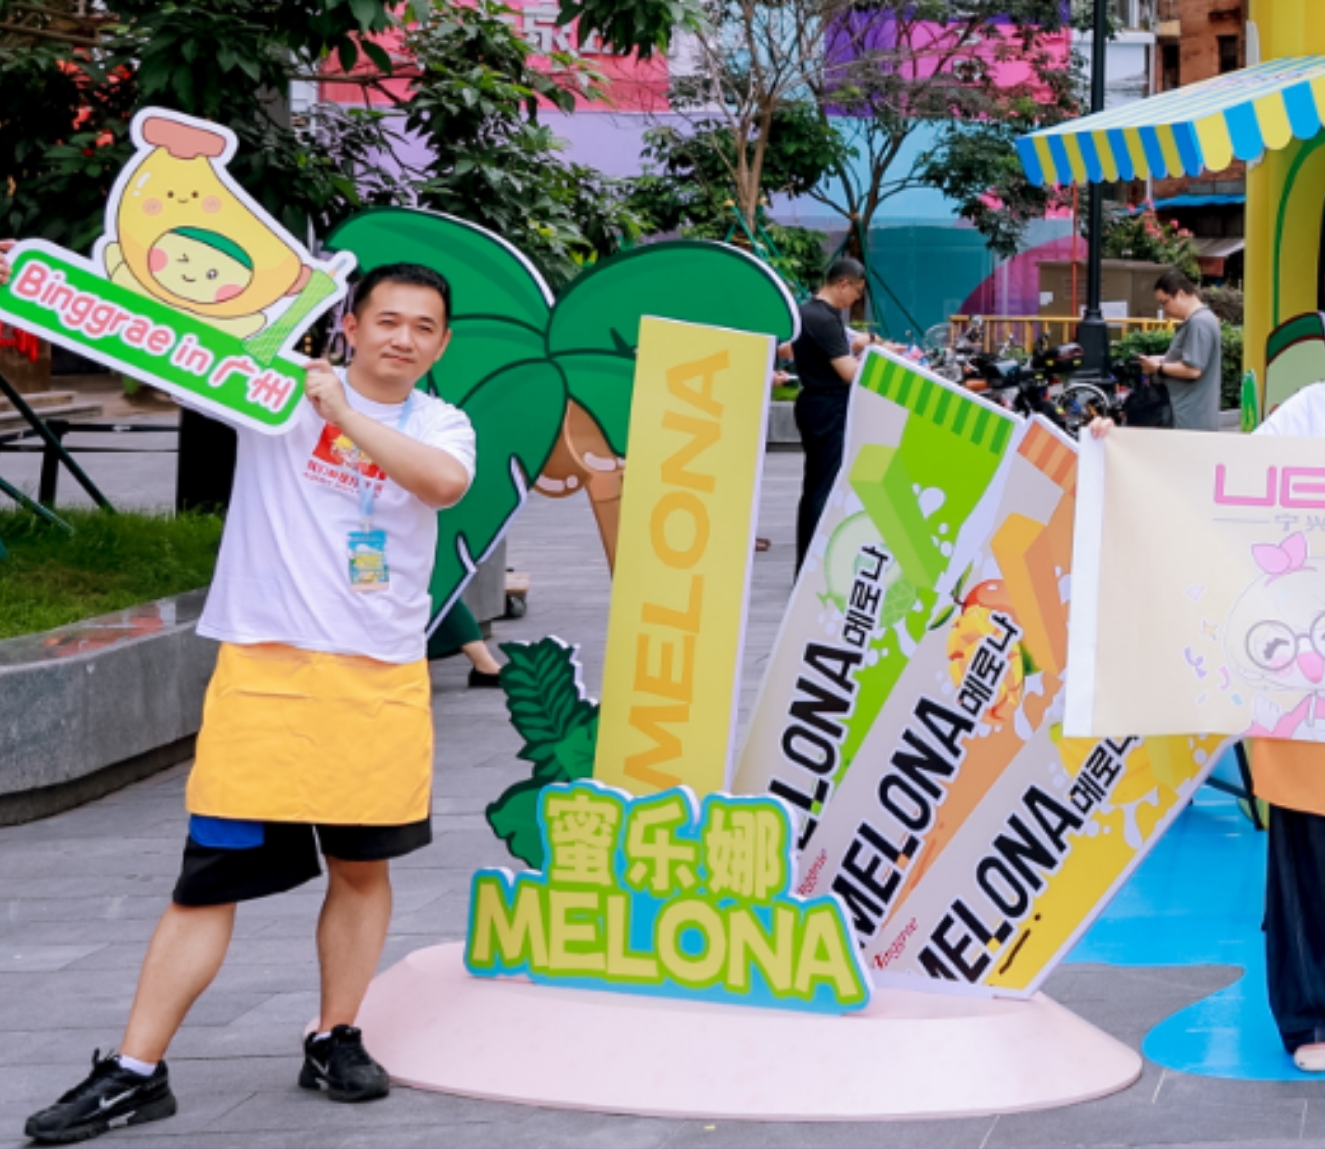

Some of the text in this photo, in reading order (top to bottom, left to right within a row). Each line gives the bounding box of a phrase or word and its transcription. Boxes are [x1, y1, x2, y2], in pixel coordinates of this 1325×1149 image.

[15, 262, 174, 354] Binggrae
[173, 335, 213, 372] in
[212, 358, 299, 411] 广州
[622, 350, 732, 794] MELONA
[841, 545, 893, 648] 메로나
[954, 615, 1024, 720] 메로나
[543, 796, 784, 900] 蜜乐娜
[830, 696, 978, 948] MELONA
[916, 784, 1085, 986] MELONA
[470, 882, 861, 1005] MELONA
